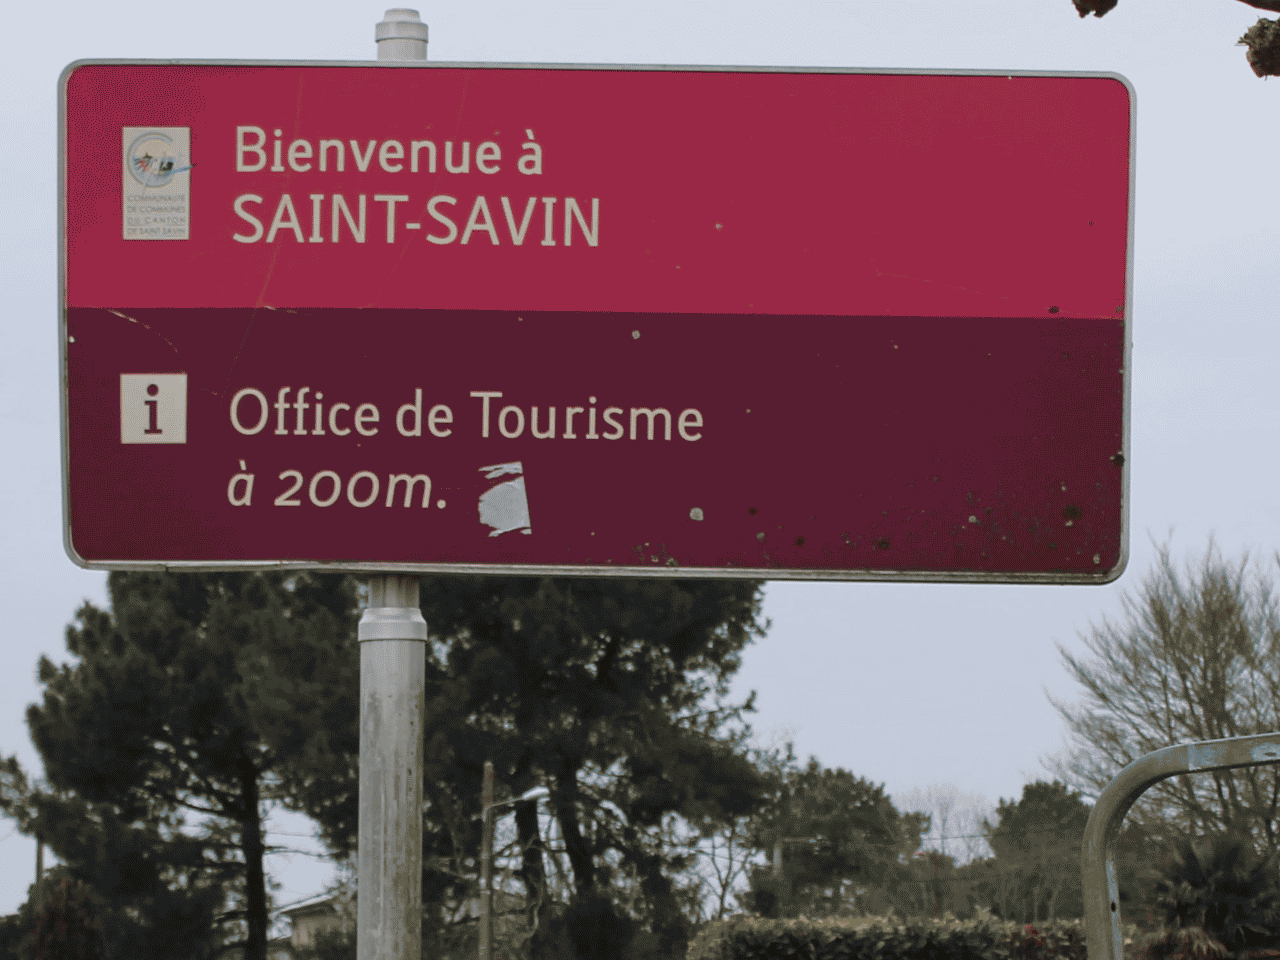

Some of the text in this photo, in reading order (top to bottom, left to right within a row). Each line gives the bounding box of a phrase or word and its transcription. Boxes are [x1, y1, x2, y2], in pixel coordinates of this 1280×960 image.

[236, 125, 543, 175] Bienvenue à
[232, 193, 600, 247] SAINT-SAVIN
[144, 384, 163, 434] i
[230, 386, 704, 441] Office de Tourisme
[227, 458, 447, 508] à 200m.
